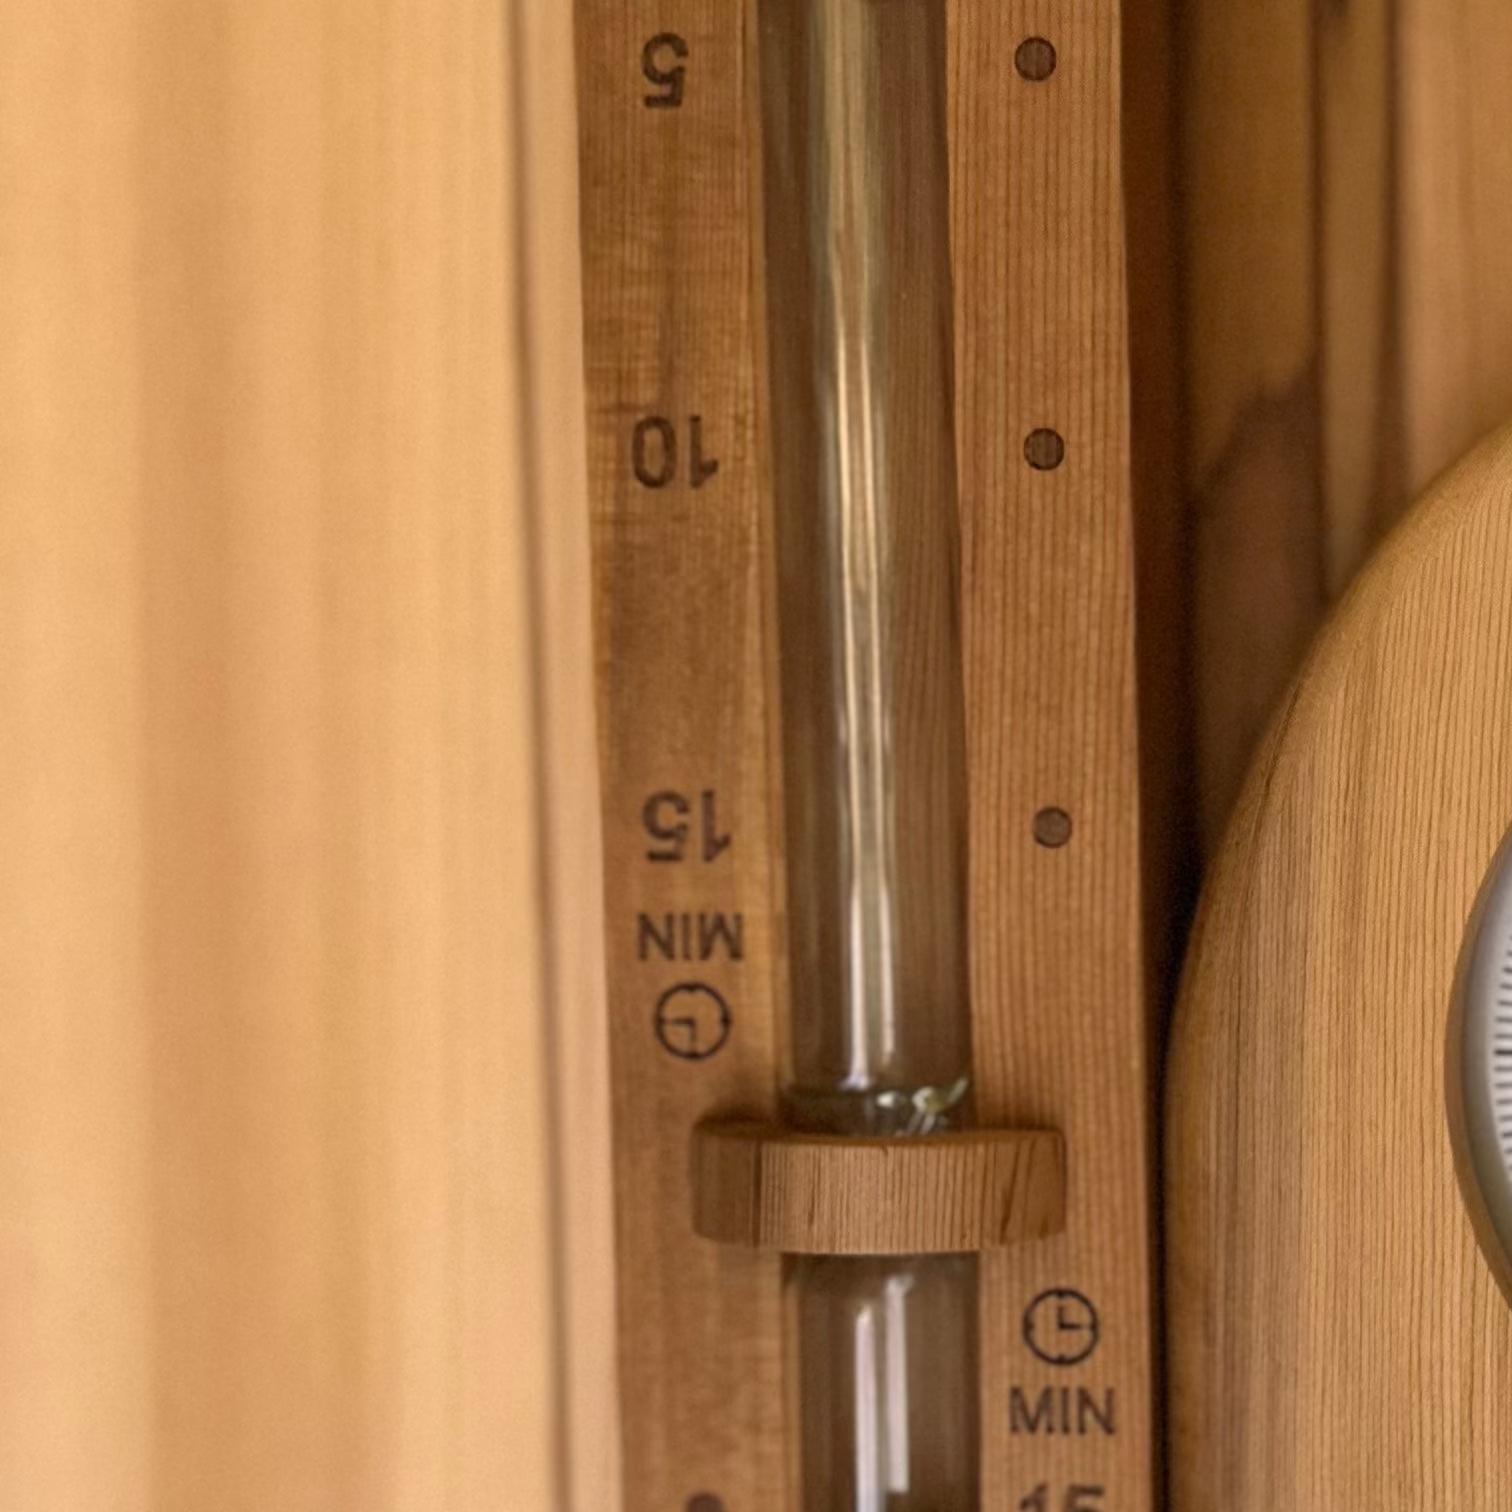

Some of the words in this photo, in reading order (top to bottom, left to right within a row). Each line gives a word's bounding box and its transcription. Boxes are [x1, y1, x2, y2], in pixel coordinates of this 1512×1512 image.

[641, 32, 689, 108] 5
[632, 415, 719, 489] 10
[642, 790, 731, 862] 15
[638, 913, 742, 961] MIN
[1009, 1387, 1116, 1435] MIN
